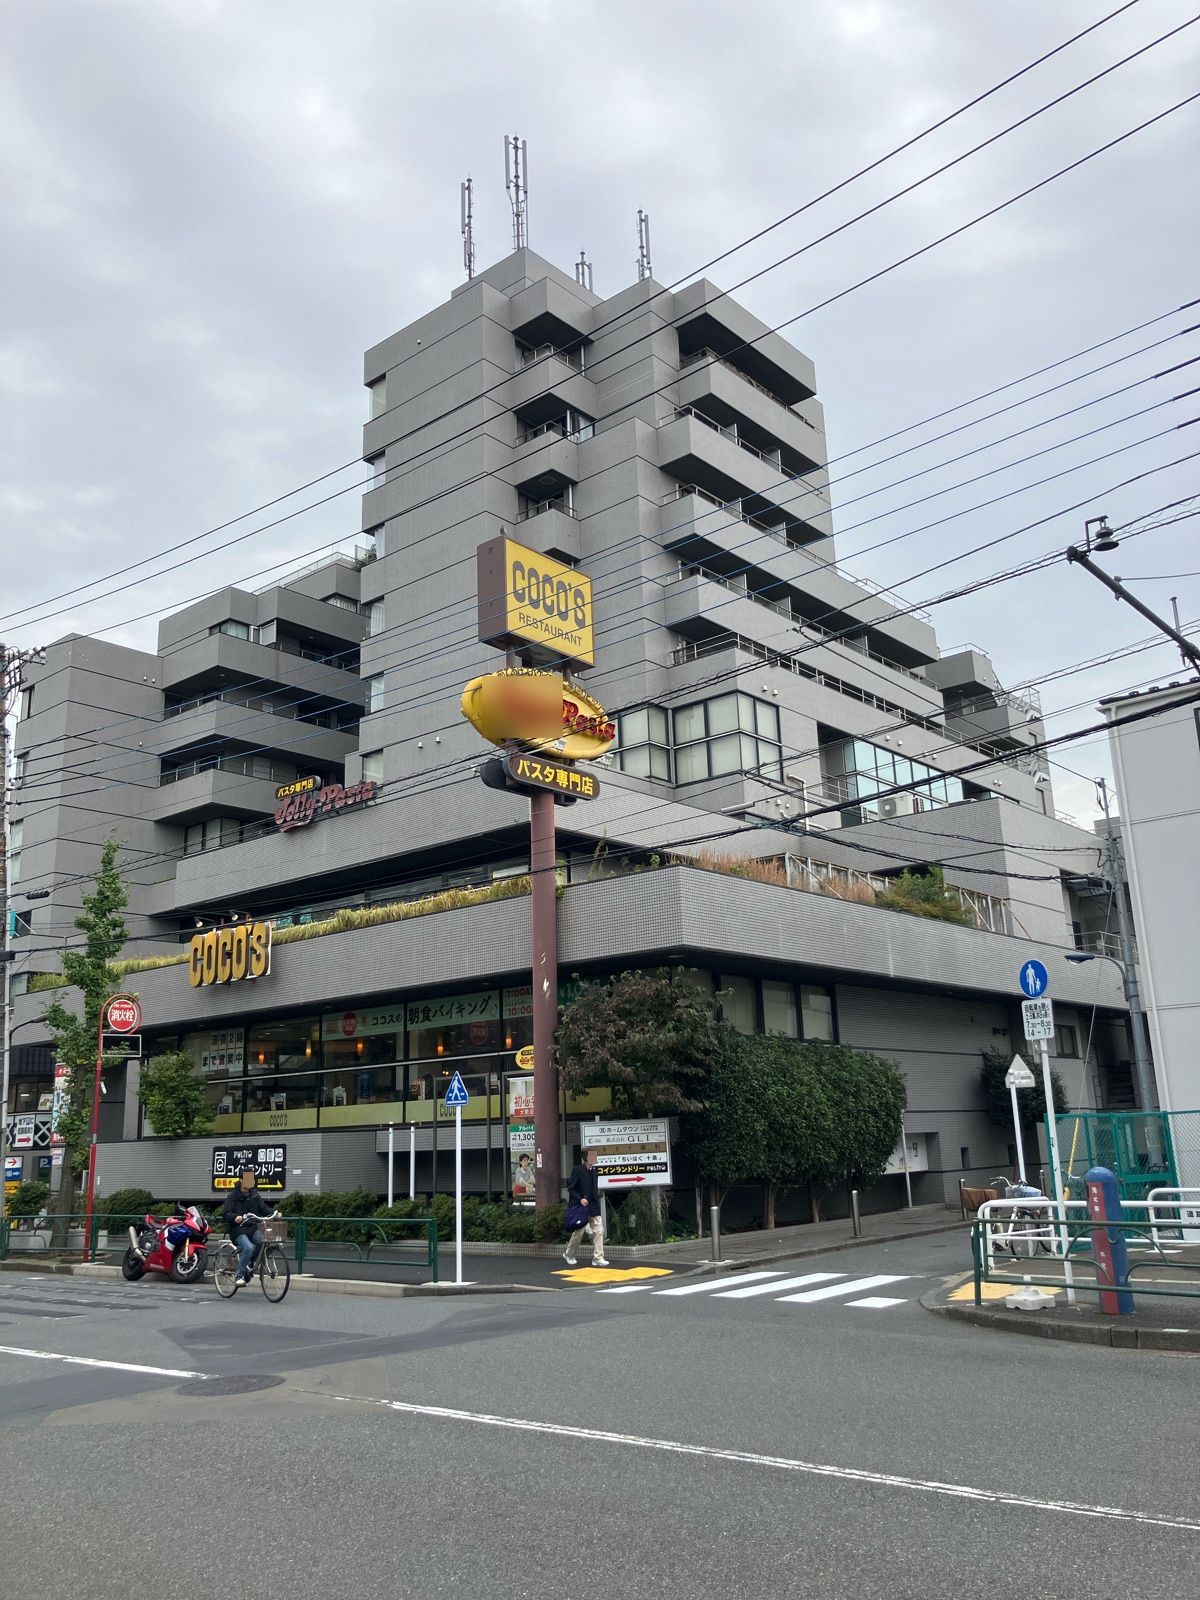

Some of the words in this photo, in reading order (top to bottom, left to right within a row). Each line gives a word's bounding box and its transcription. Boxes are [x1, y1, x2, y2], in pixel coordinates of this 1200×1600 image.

[512, 560, 586, 629] COCO'S
[518, 611, 582, 647] RESTAURANT
[518, 759, 594, 796] パスタ専門店
[277, 778, 314, 798] パスタ専門店
[189, 922, 270, 988] COCO'S
[111, 1009, 134, 1021] 消火栓
[372, 1014, 402, 1026] ココスの
[408, 995, 492, 1025] 朝食バイキング
[507, 1005, 533, 1016] 10:00
[439, 1103, 463, 1117] COCO
[269, 1114, 288, 1127] COCO'S
[597, 1165, 645, 1174] コインランドリー
